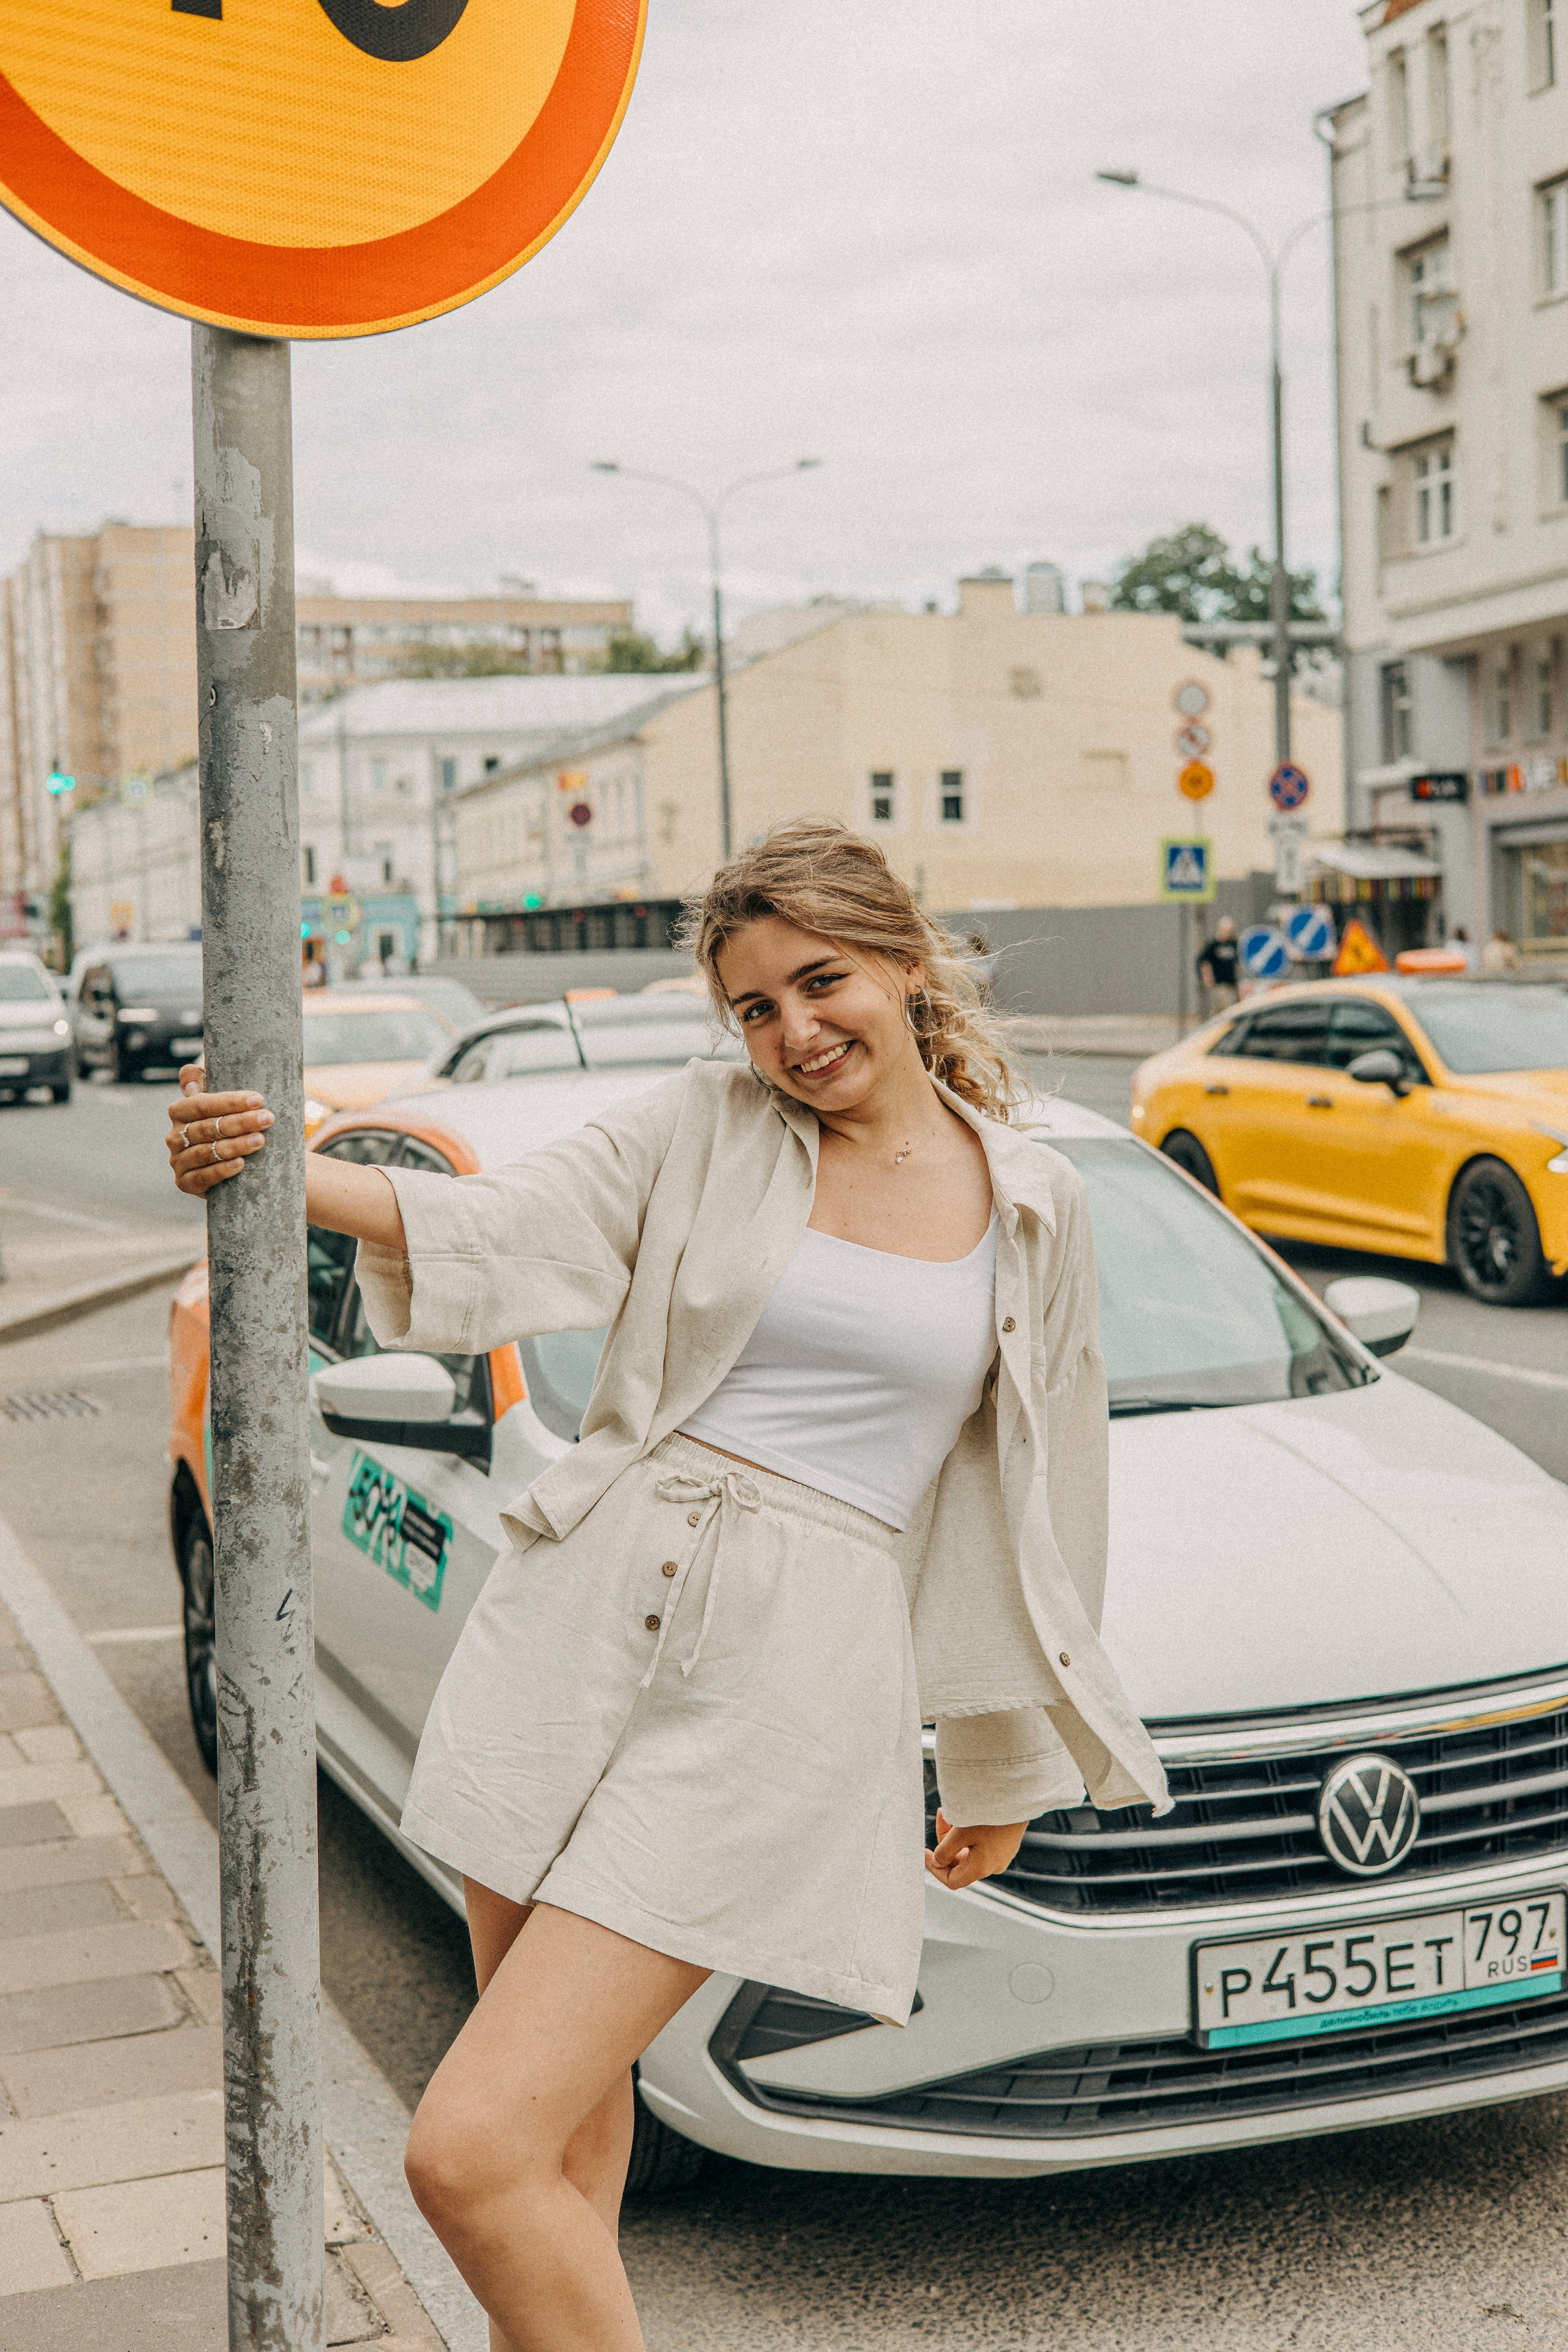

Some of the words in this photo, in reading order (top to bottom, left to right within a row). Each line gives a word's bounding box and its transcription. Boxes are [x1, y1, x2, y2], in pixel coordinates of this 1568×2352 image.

[1221, 1934, 1453, 2018] Р455ЕТ
[1471, 1902, 1551, 1961] 797
[1487, 1956, 1528, 1978] RUS
